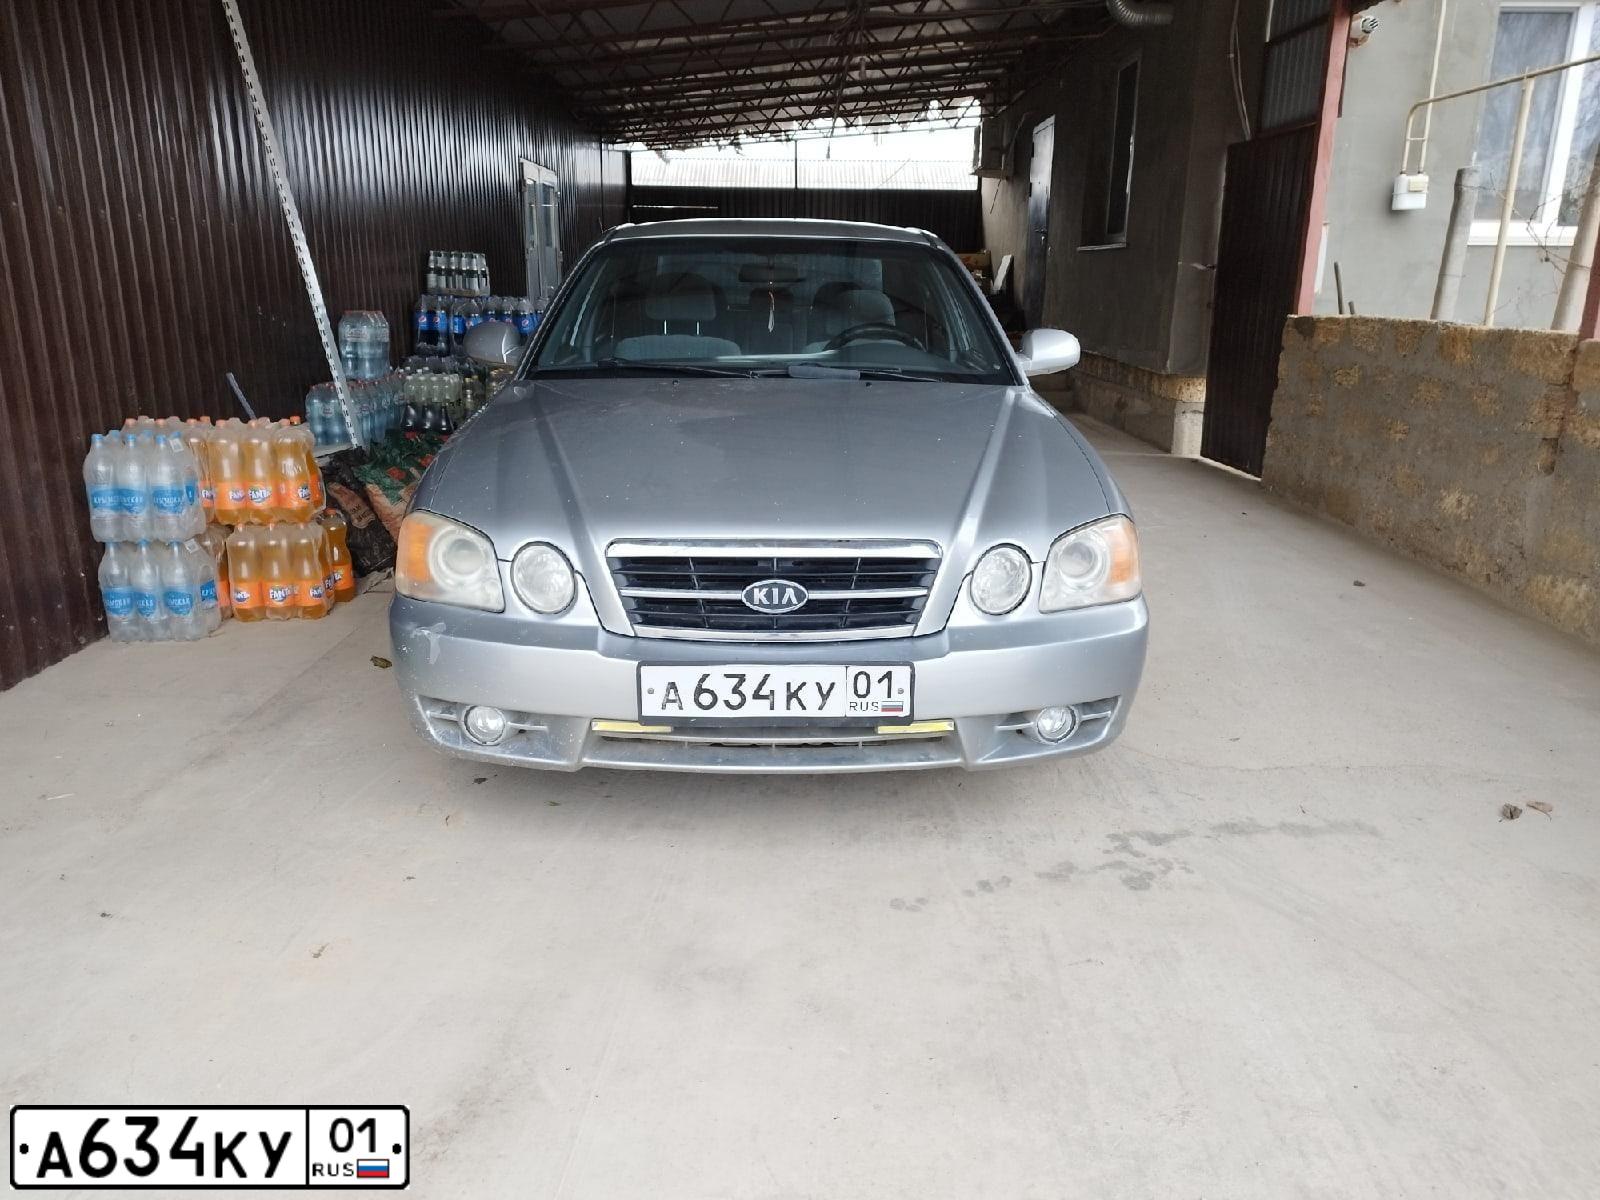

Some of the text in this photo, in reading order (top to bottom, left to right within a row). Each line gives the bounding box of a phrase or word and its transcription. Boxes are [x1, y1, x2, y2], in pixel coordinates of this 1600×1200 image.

[752, 587, 798, 605] KIA
[853, 670, 893, 699] 01
[849, 701, 879, 712] RUS
